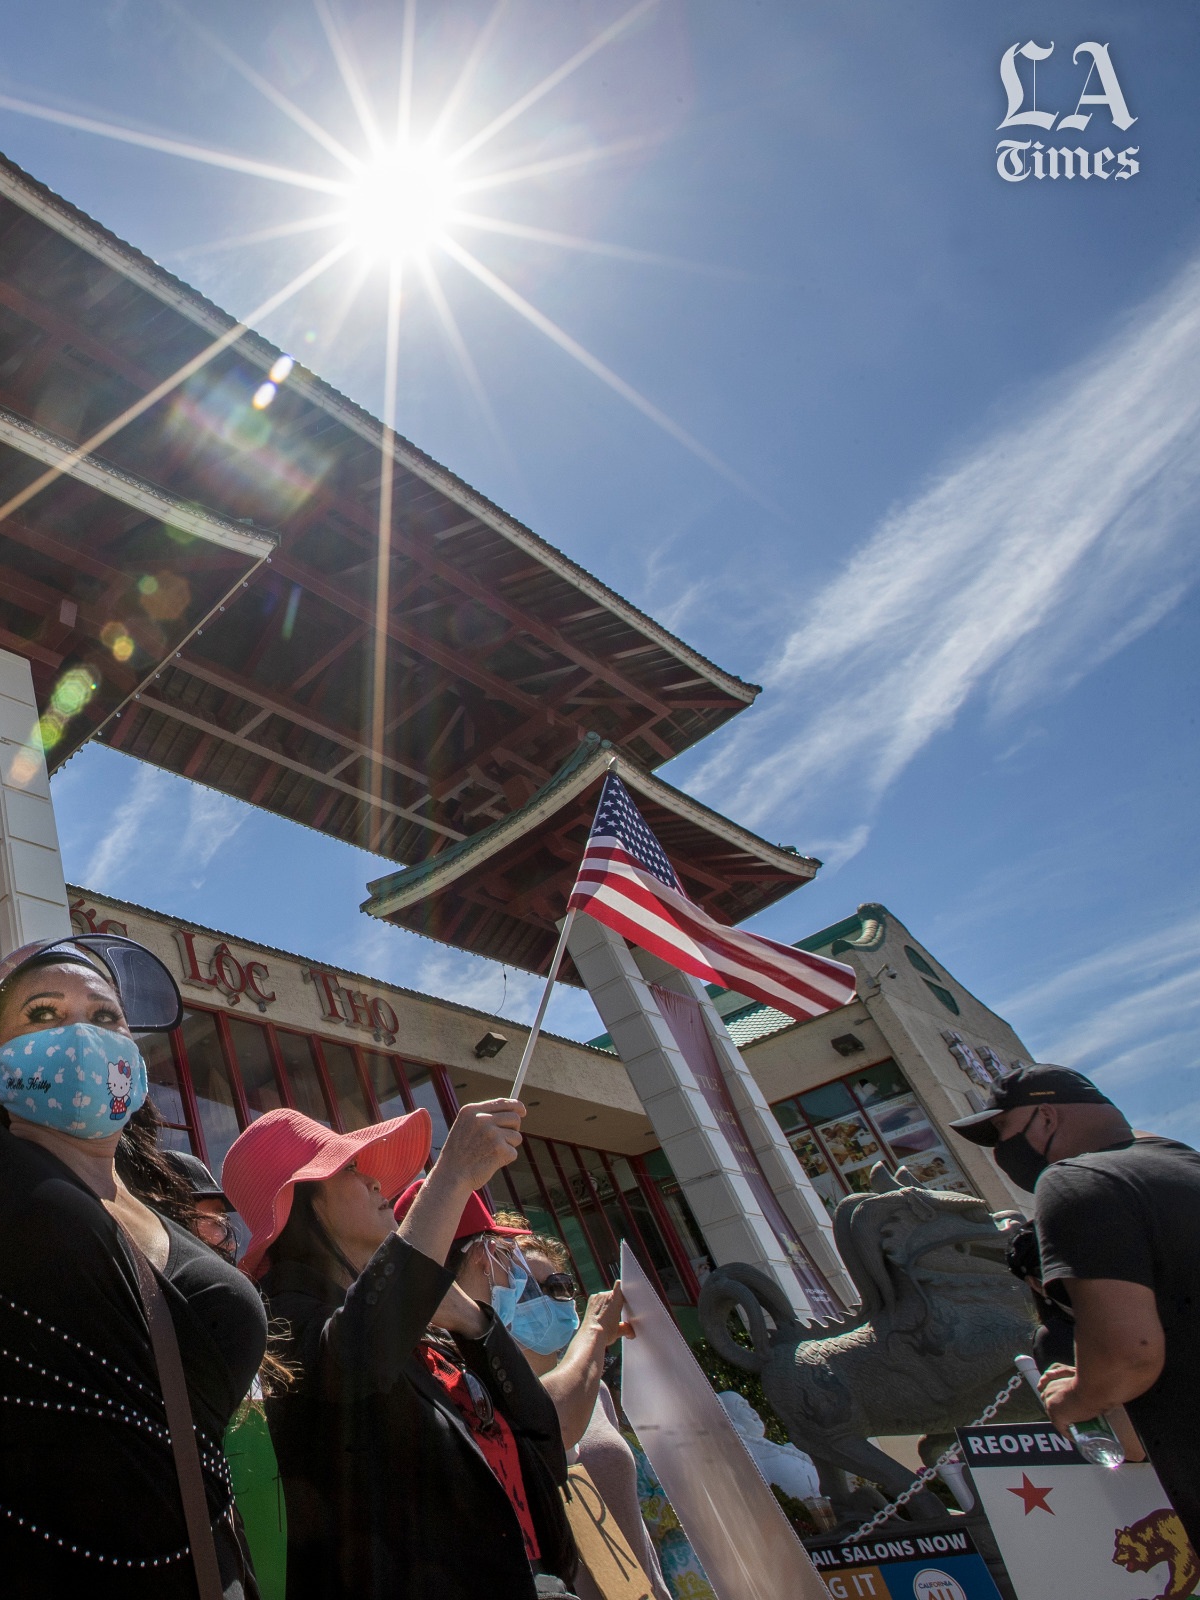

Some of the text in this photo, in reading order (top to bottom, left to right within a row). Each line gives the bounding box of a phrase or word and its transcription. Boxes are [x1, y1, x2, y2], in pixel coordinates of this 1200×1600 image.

[26, 1077, 51, 1093] Kitty
[967, 1433, 1074, 1454] REOPEN
[811, 1533, 968, 1567] AIL SALONS NOW
[852, 1574, 877, 1597] IT
